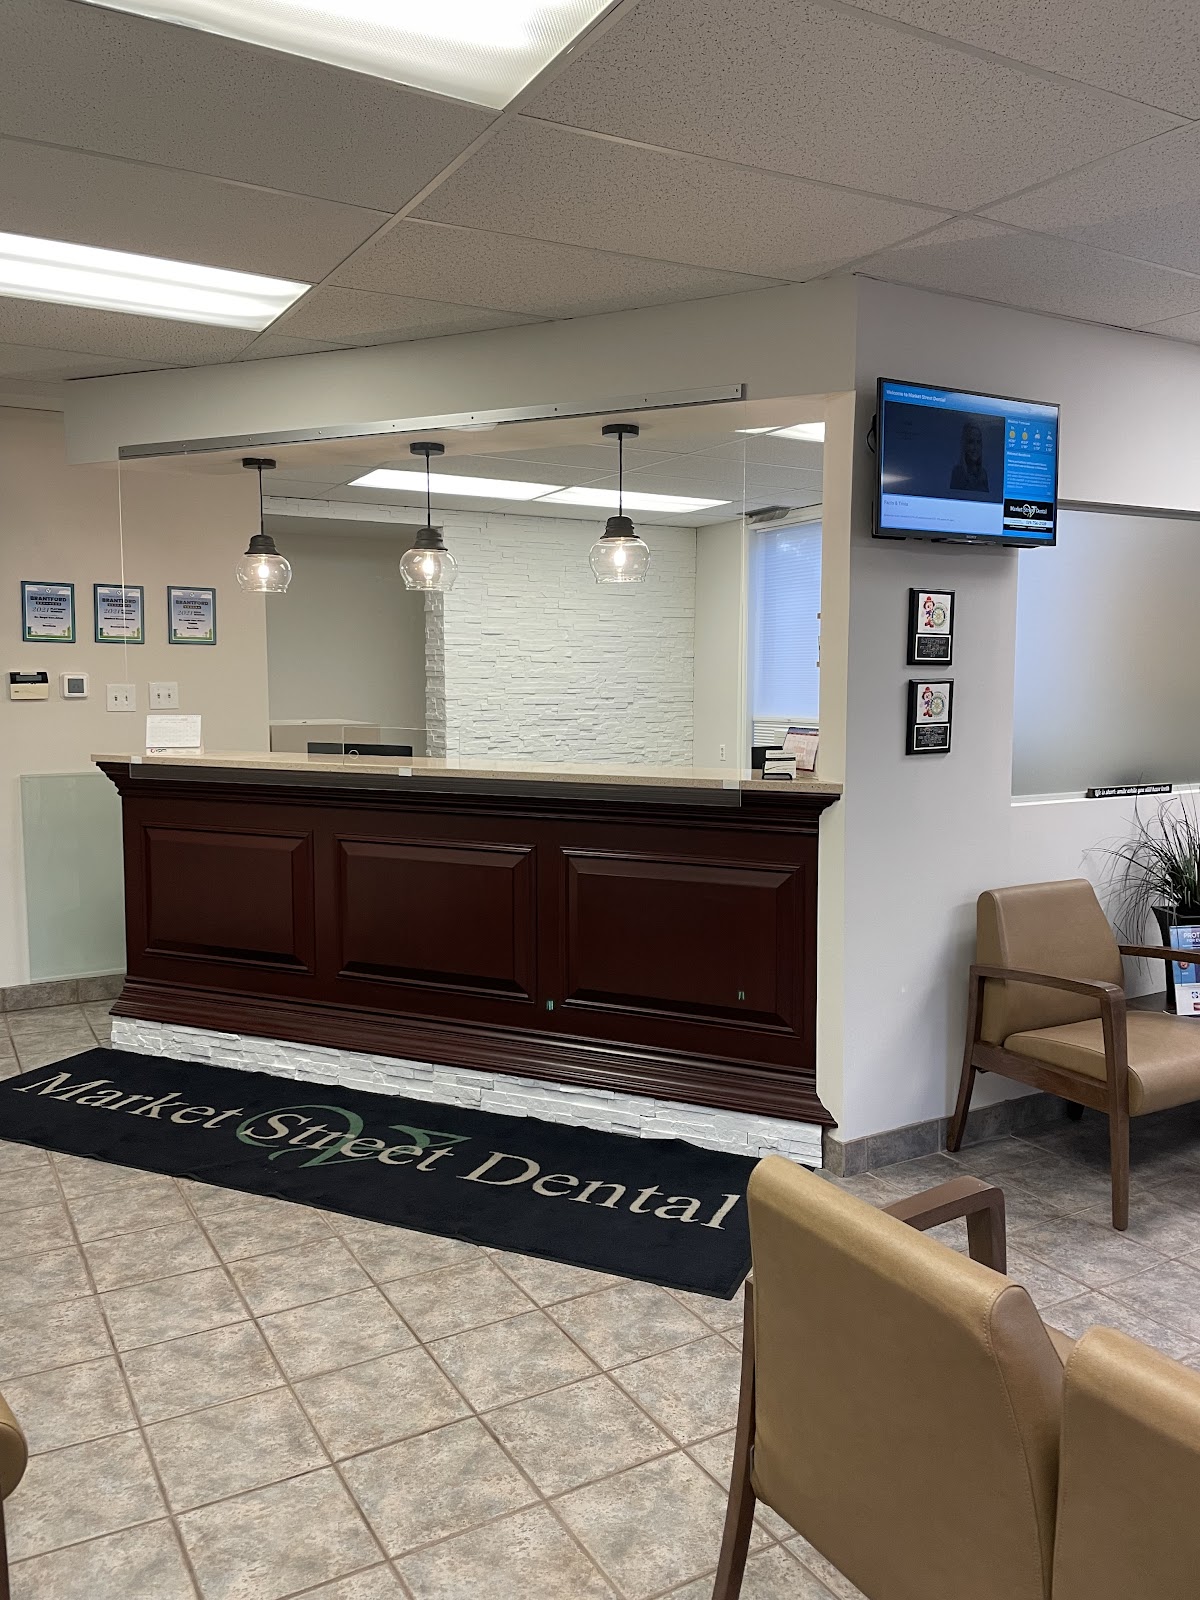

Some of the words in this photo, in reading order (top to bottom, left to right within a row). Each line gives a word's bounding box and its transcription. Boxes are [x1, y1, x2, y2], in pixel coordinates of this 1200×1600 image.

[12, 1071, 244, 1129] Market
[240, 1113, 455, 1172] Street
[455, 1151, 741, 1230] Dental
